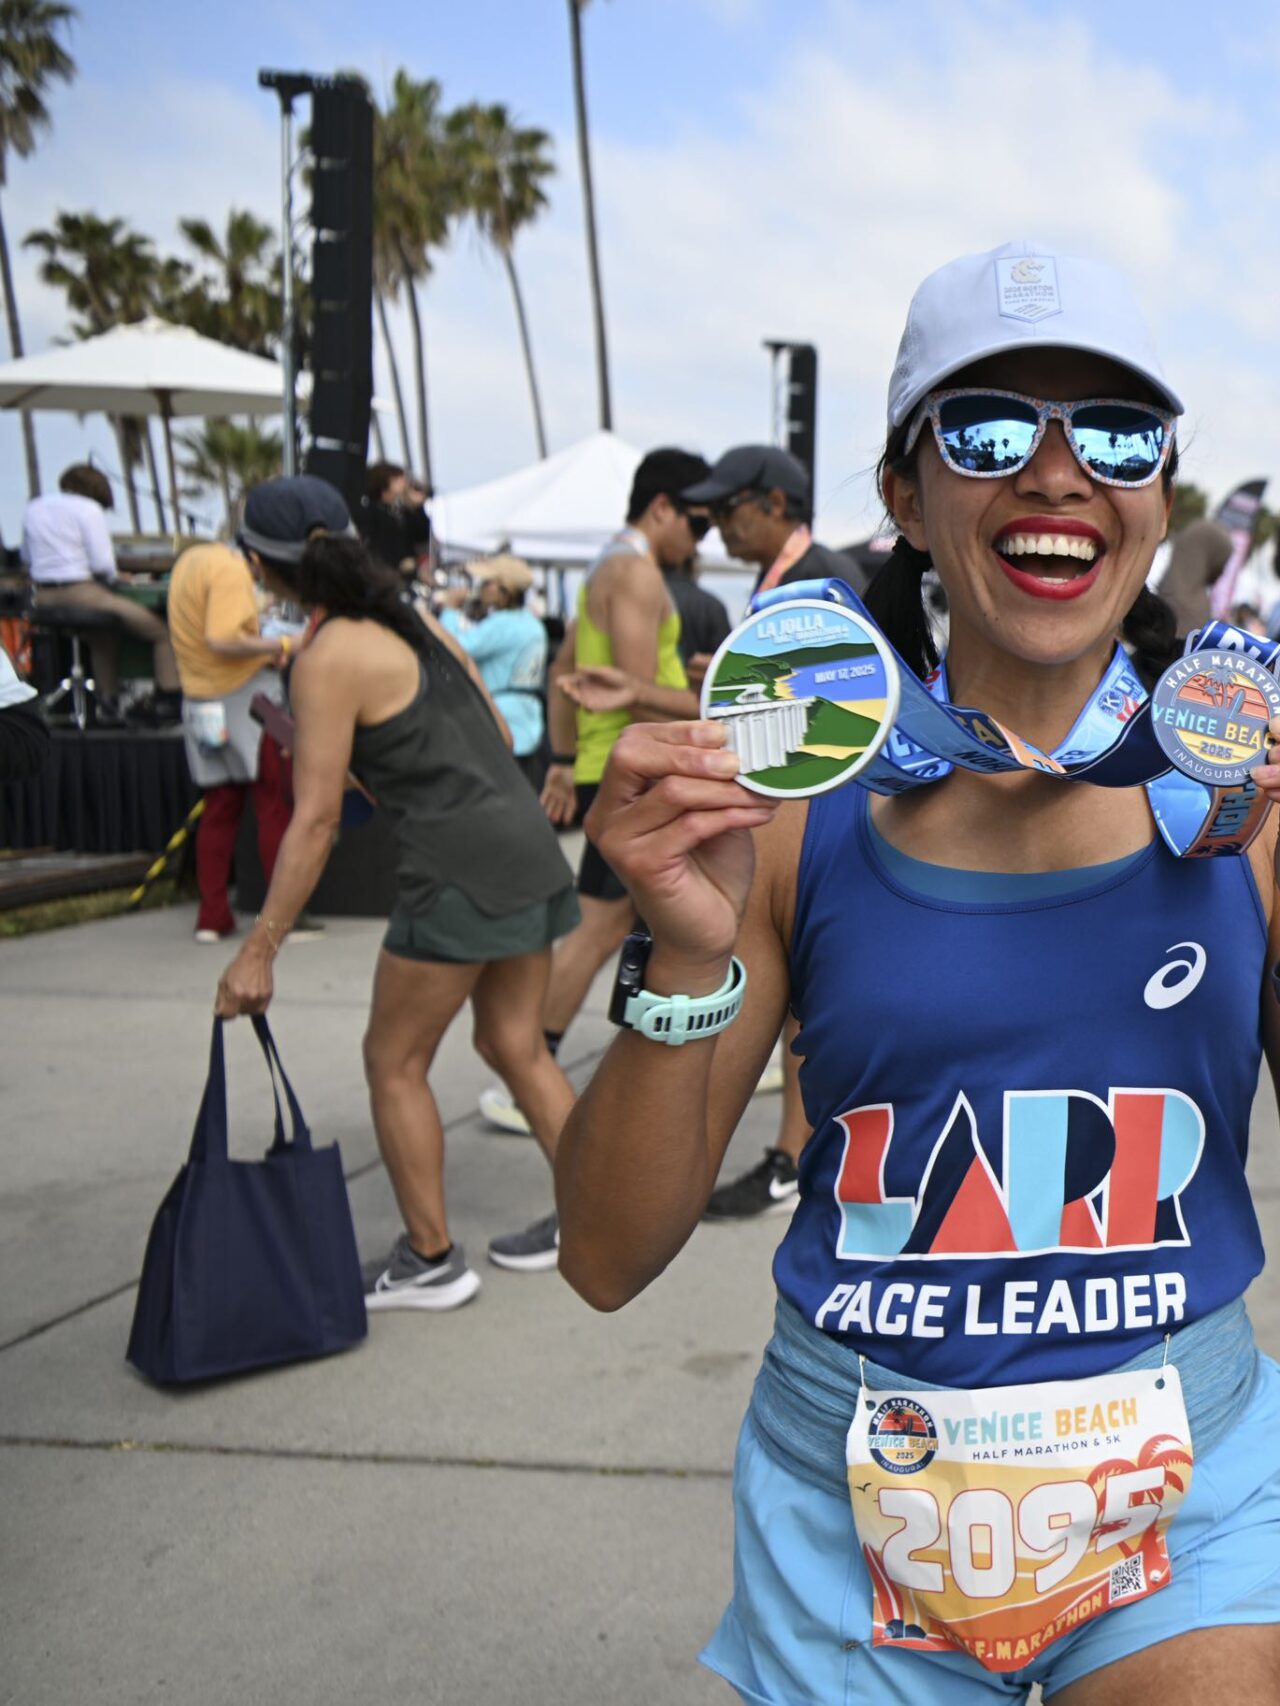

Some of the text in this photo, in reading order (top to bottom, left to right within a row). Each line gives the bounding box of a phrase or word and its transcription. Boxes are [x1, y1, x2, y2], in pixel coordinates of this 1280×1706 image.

[756, 613, 824, 640] LA JOLLA
[814, 671, 836, 684] MAY
[850, 664, 876, 678] 2025
[1166, 658, 1202, 689] HALF
[1152, 702, 1275, 751] VENICE BEAC
[1173, 748, 1251, 778] INAUGURAL
[1199, 741, 1234, 759] 2025
[814, 1271, 1187, 1338] PACE LEADER
[872, 1399, 934, 1428] HALF MARATHON
[944, 1397, 1138, 1446] VENICE BEACH
[867, 1434, 939, 1451] VENICE BEACH
[896, 1452, 915, 1460] 2025
[972, 1434, 1122, 1461] HALF MARATHON & 5K
[880, 1459, 926, 1474] INAUGURAL
[877, 1465, 1166, 1600] 2095
[994, 1592, 1104, 1661] MARATHON
